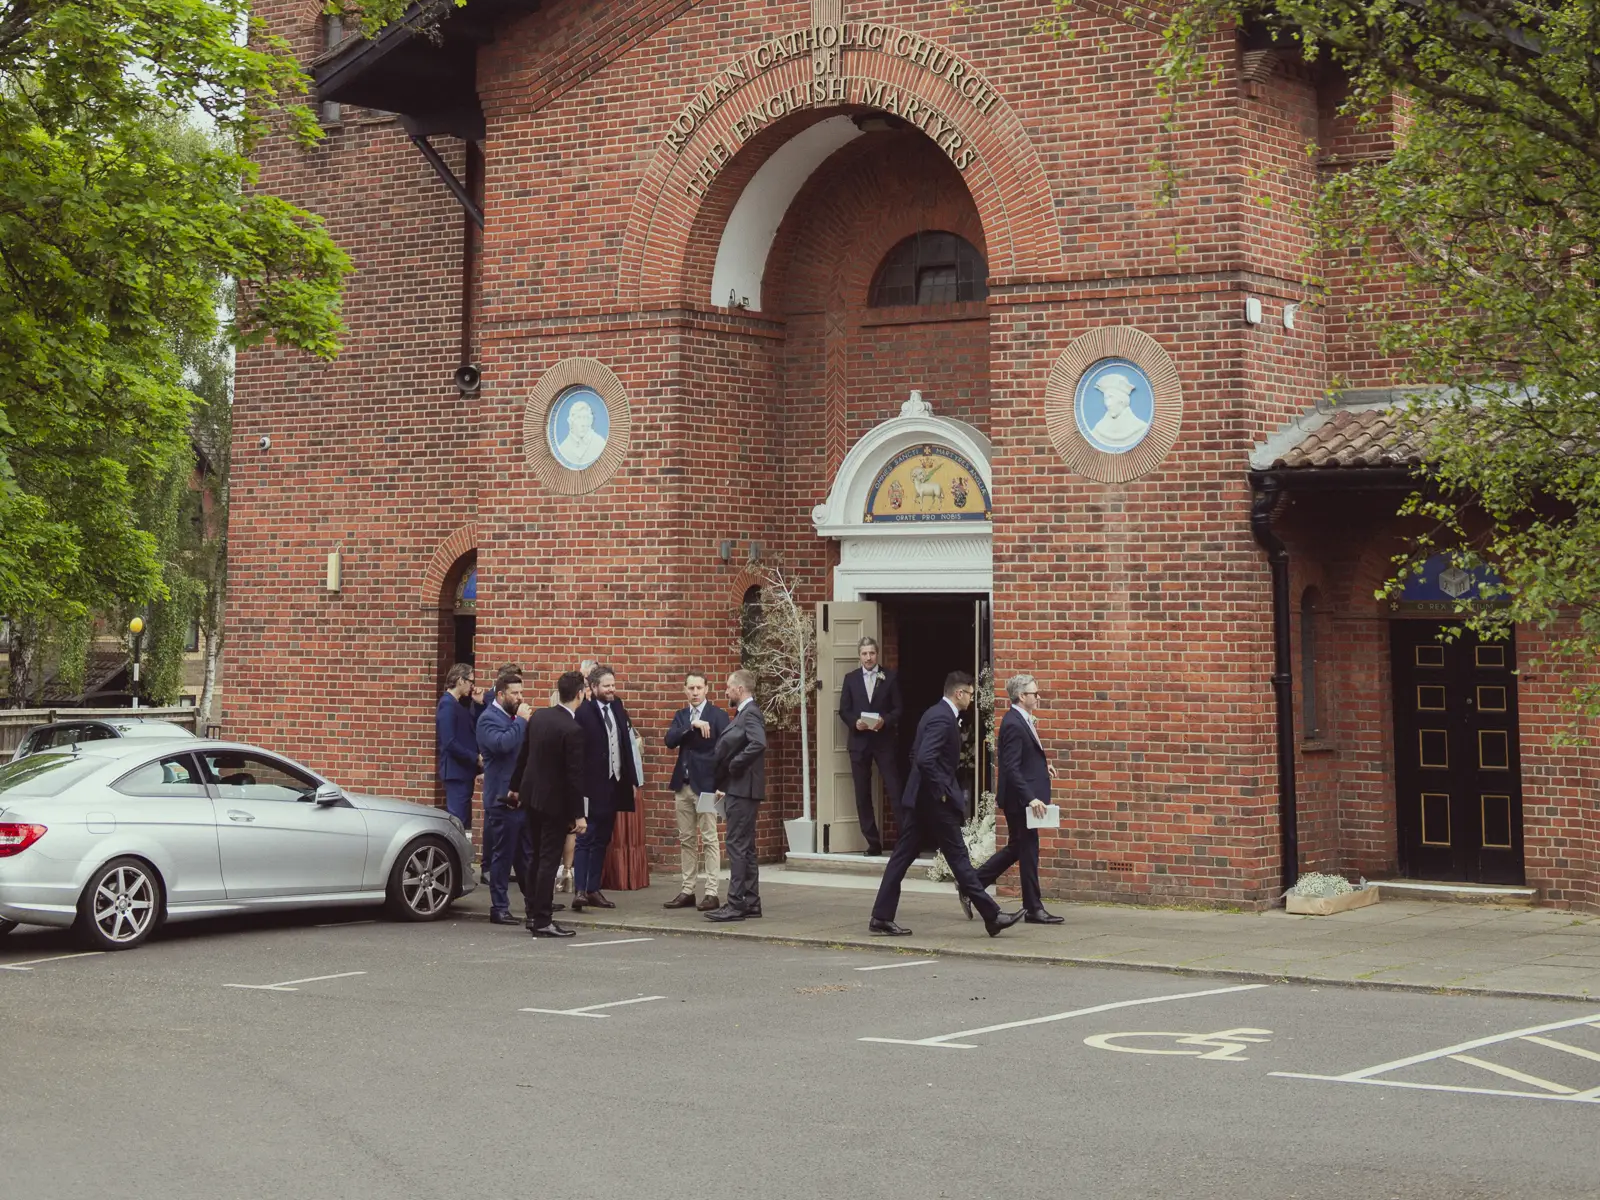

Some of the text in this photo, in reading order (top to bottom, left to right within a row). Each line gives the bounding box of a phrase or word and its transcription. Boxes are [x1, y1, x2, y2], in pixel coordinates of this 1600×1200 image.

[664, 23, 997, 154] ROMAN CATHOLIC CHURCH
[813, 52, 837, 76] of
[684, 77, 976, 199] THE ENGLISH MARTYRS
[874, 466, 893, 489] OMNES
[894, 449, 919, 464] SANCTI
[935, 448, 970, 470] MARTYRES
